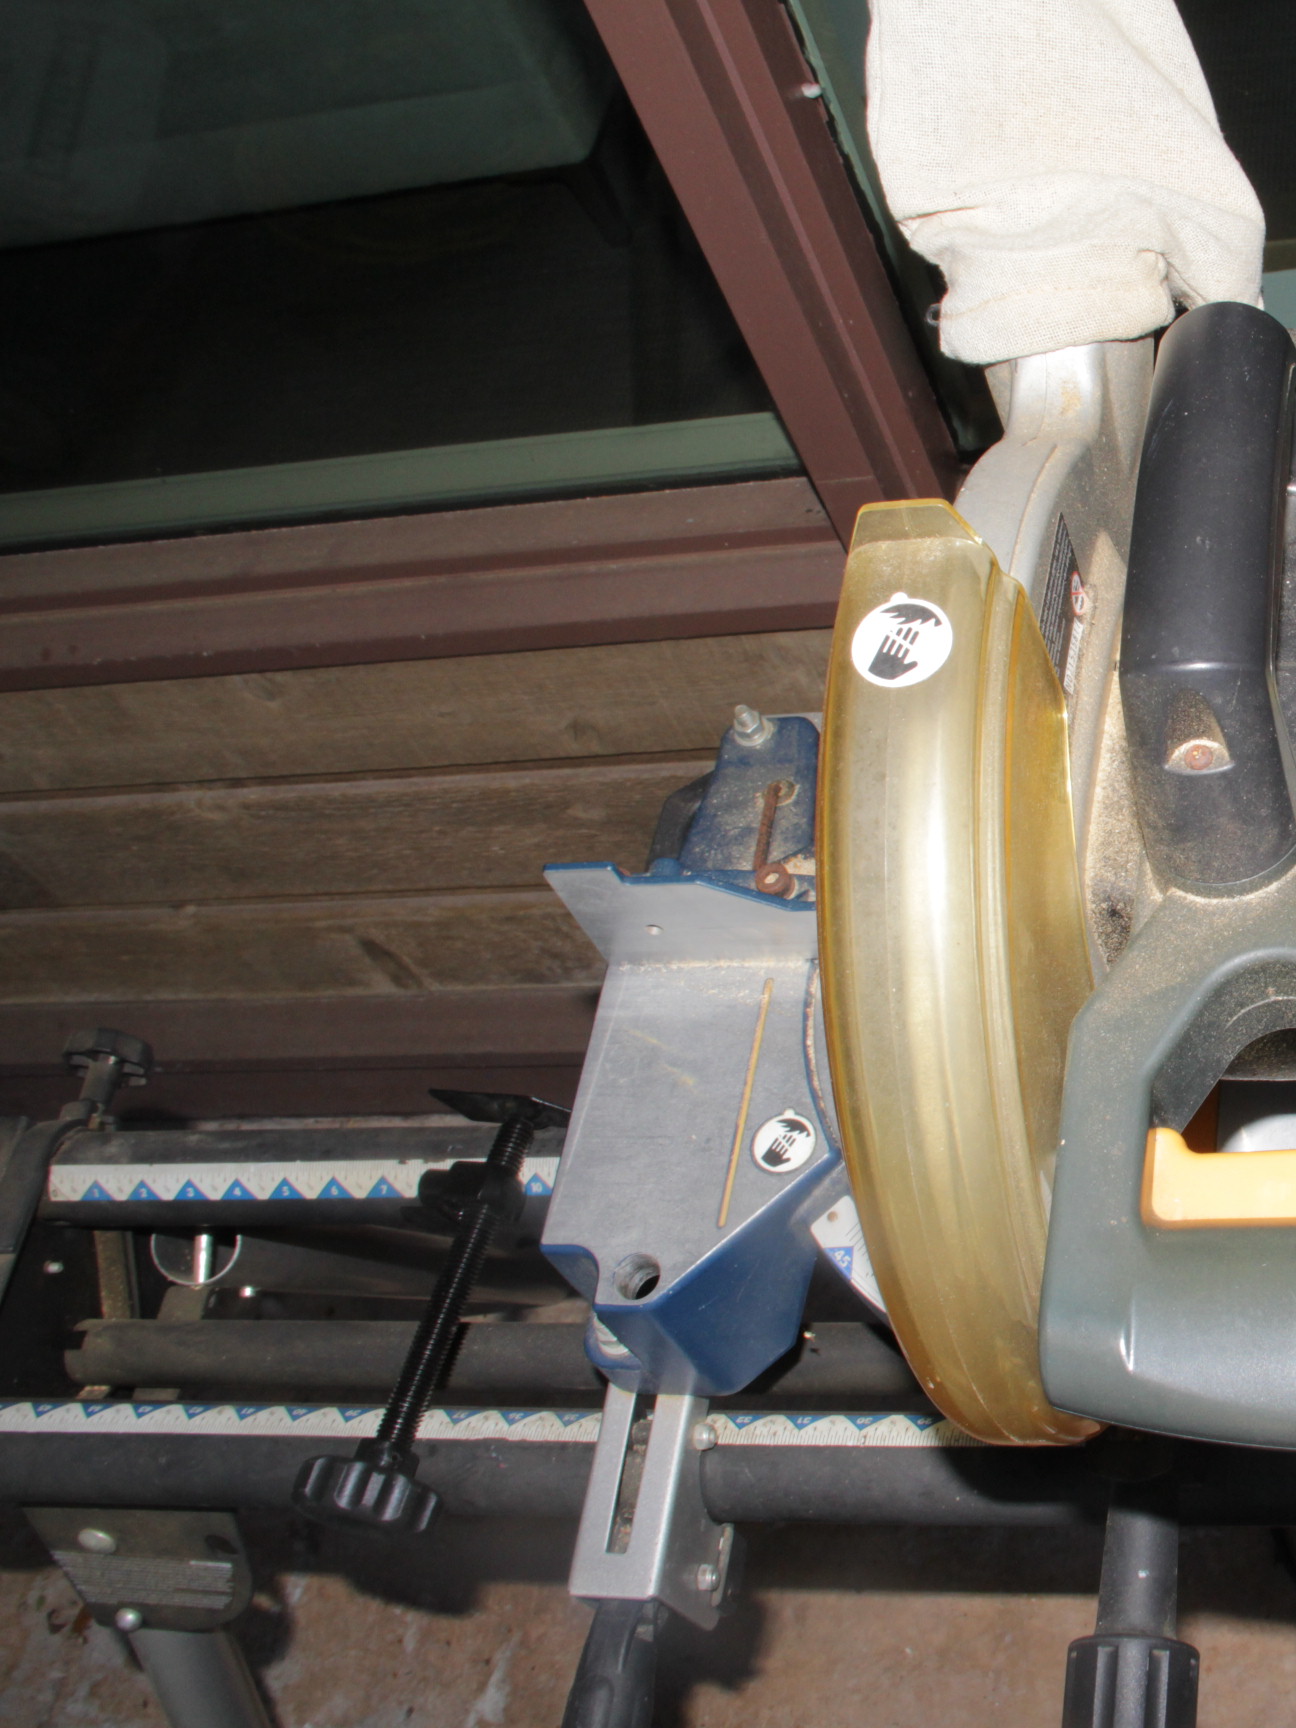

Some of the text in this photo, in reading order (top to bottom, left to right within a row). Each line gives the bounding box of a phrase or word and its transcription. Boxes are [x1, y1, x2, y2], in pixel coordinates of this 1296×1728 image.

[92, 1182, 543, 1197] 1 2 3 4 5 6 7 10
[832, 1247, 852, 1269] 45
